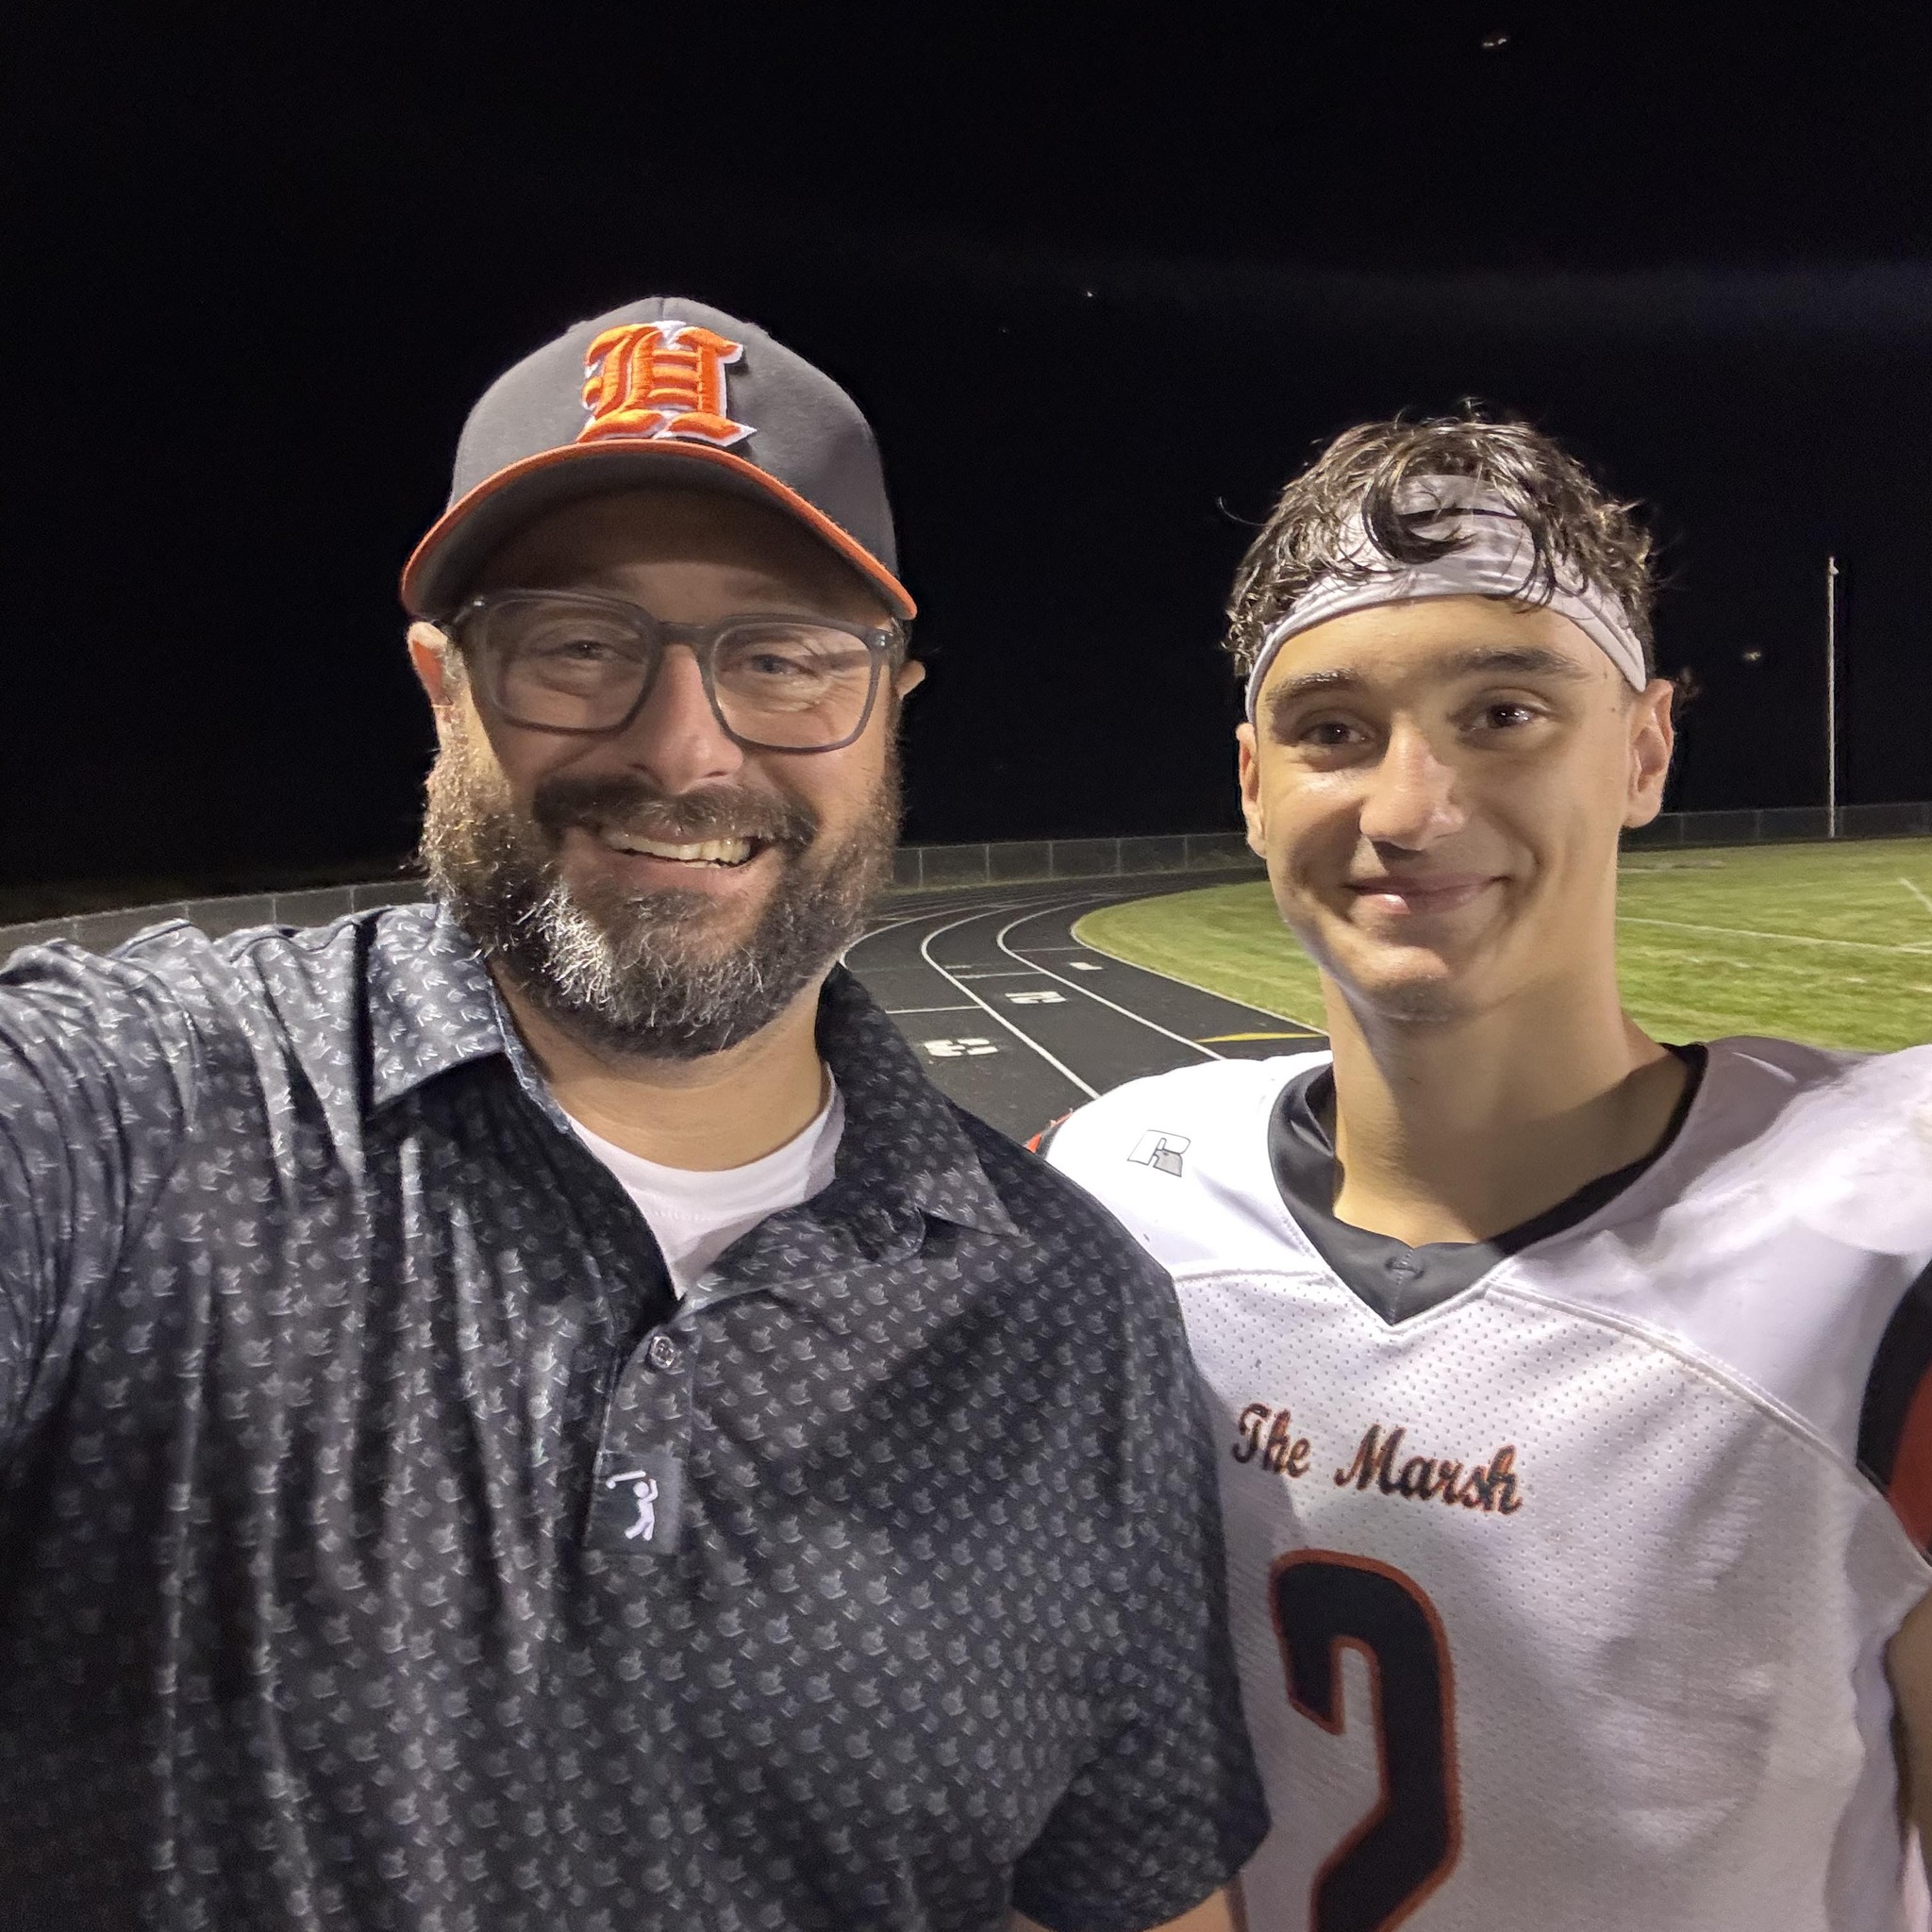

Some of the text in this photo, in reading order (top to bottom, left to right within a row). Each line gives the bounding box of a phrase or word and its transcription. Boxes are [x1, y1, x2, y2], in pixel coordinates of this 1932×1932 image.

[575, 320, 757, 447] H
[1232, 1403, 1524, 1515] The Marsh
[1268, 1549, 1464, 1932] 2
